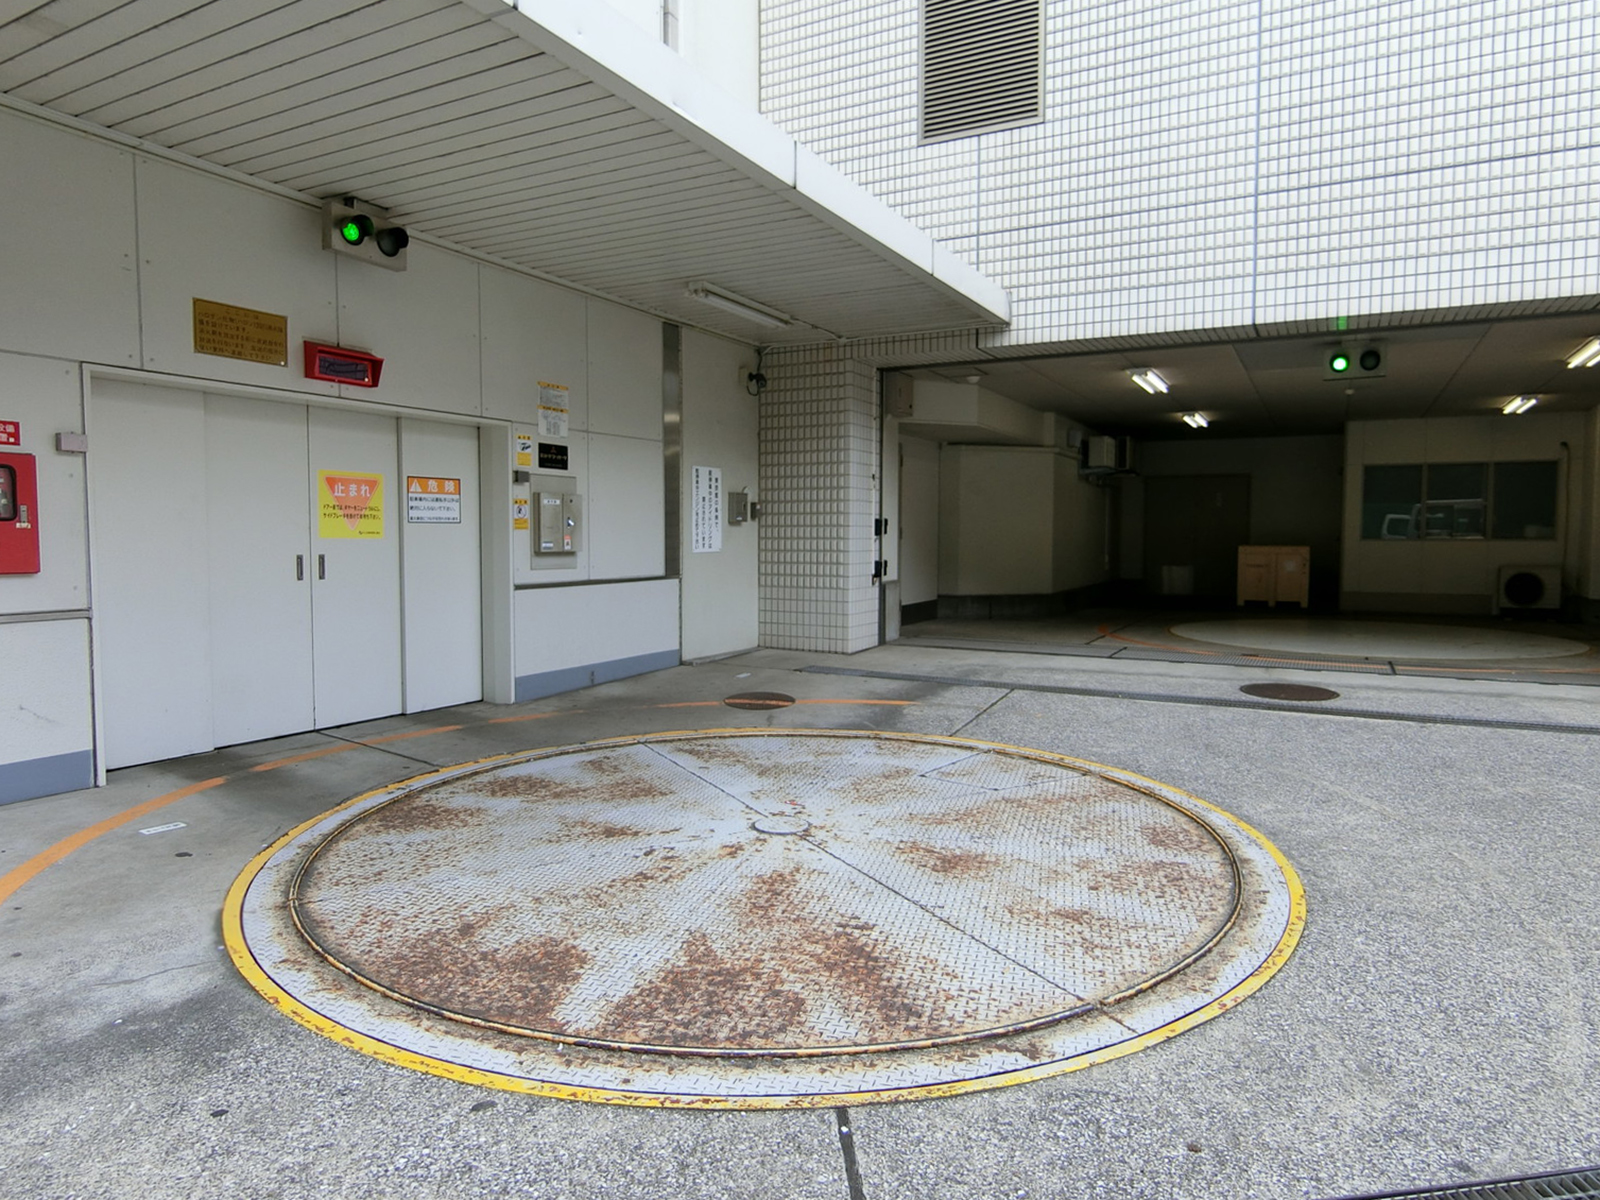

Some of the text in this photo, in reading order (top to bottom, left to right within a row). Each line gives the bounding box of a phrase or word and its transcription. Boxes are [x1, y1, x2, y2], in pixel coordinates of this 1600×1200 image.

[334, 482, 371, 497] 止まれ
[427, 479, 456, 493] 危険
